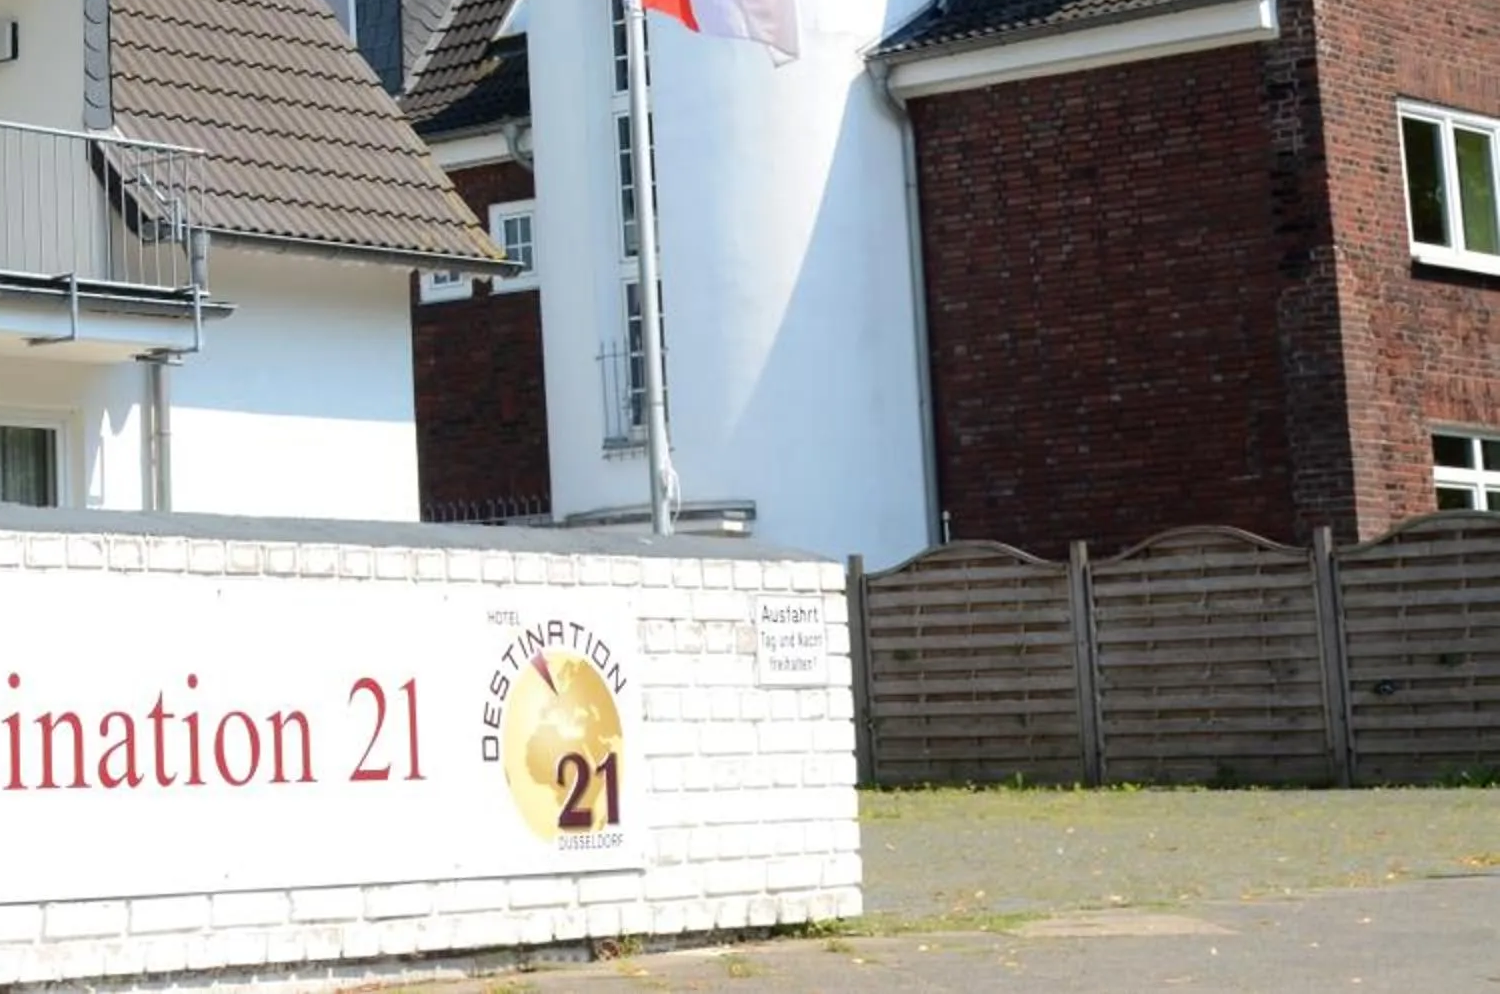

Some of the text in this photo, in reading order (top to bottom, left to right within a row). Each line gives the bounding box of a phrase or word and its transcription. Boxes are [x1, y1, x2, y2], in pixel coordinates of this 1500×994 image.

[486, 610, 520, 627] HOTEL
[761, 604, 819, 623] Ausfahrt
[347, 677, 427, 782] 21
[481, 619, 627, 763] DESTINATION
[556, 751, 620, 829] 21
